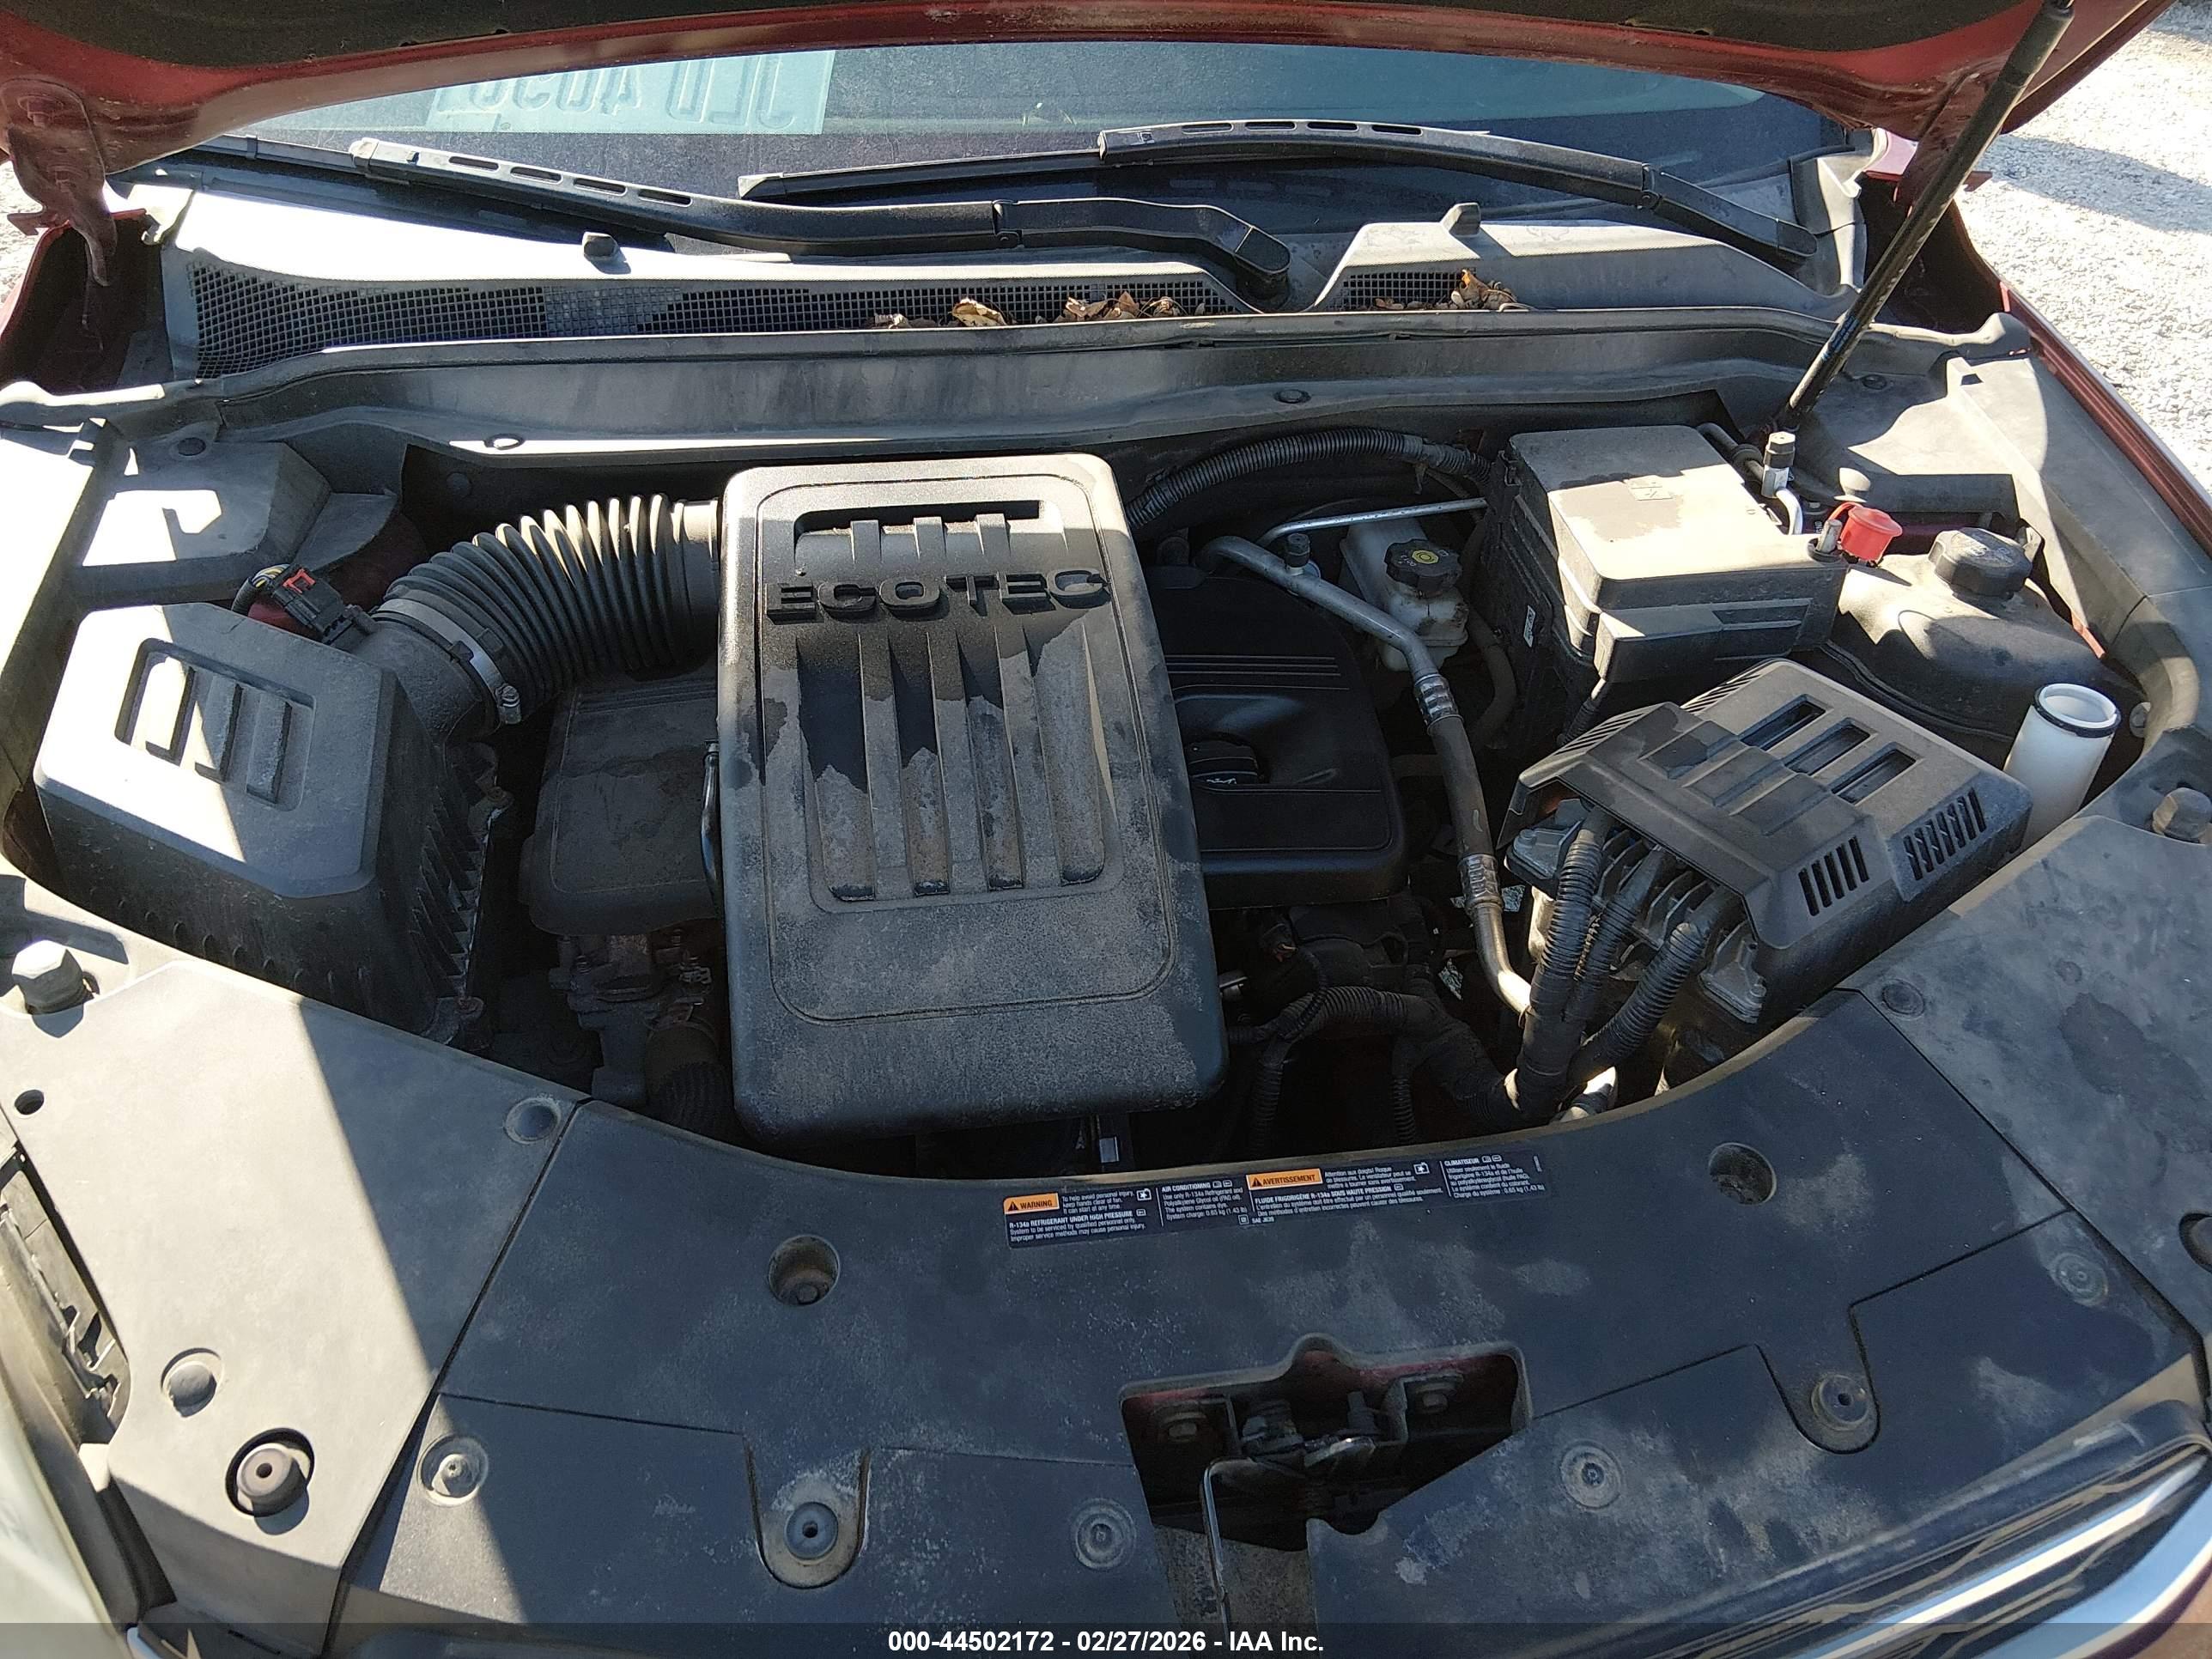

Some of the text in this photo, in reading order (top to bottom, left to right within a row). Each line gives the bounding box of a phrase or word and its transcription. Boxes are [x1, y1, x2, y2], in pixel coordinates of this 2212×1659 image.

[766, 568, 1108, 618] ECOTEC
[1263, 1175, 1316, 1185] AVERTISSEMENT
[1172, 1182, 1212, 1191] CONDITIONING
[1205, 1188, 1232, 1197] Refrigerant
[1020, 1200, 1053, 1209] WARNING
[1030, 1218, 1068, 1226] REFRIGERANT
[1104, 1211, 1133, 1219] PRESSURE
